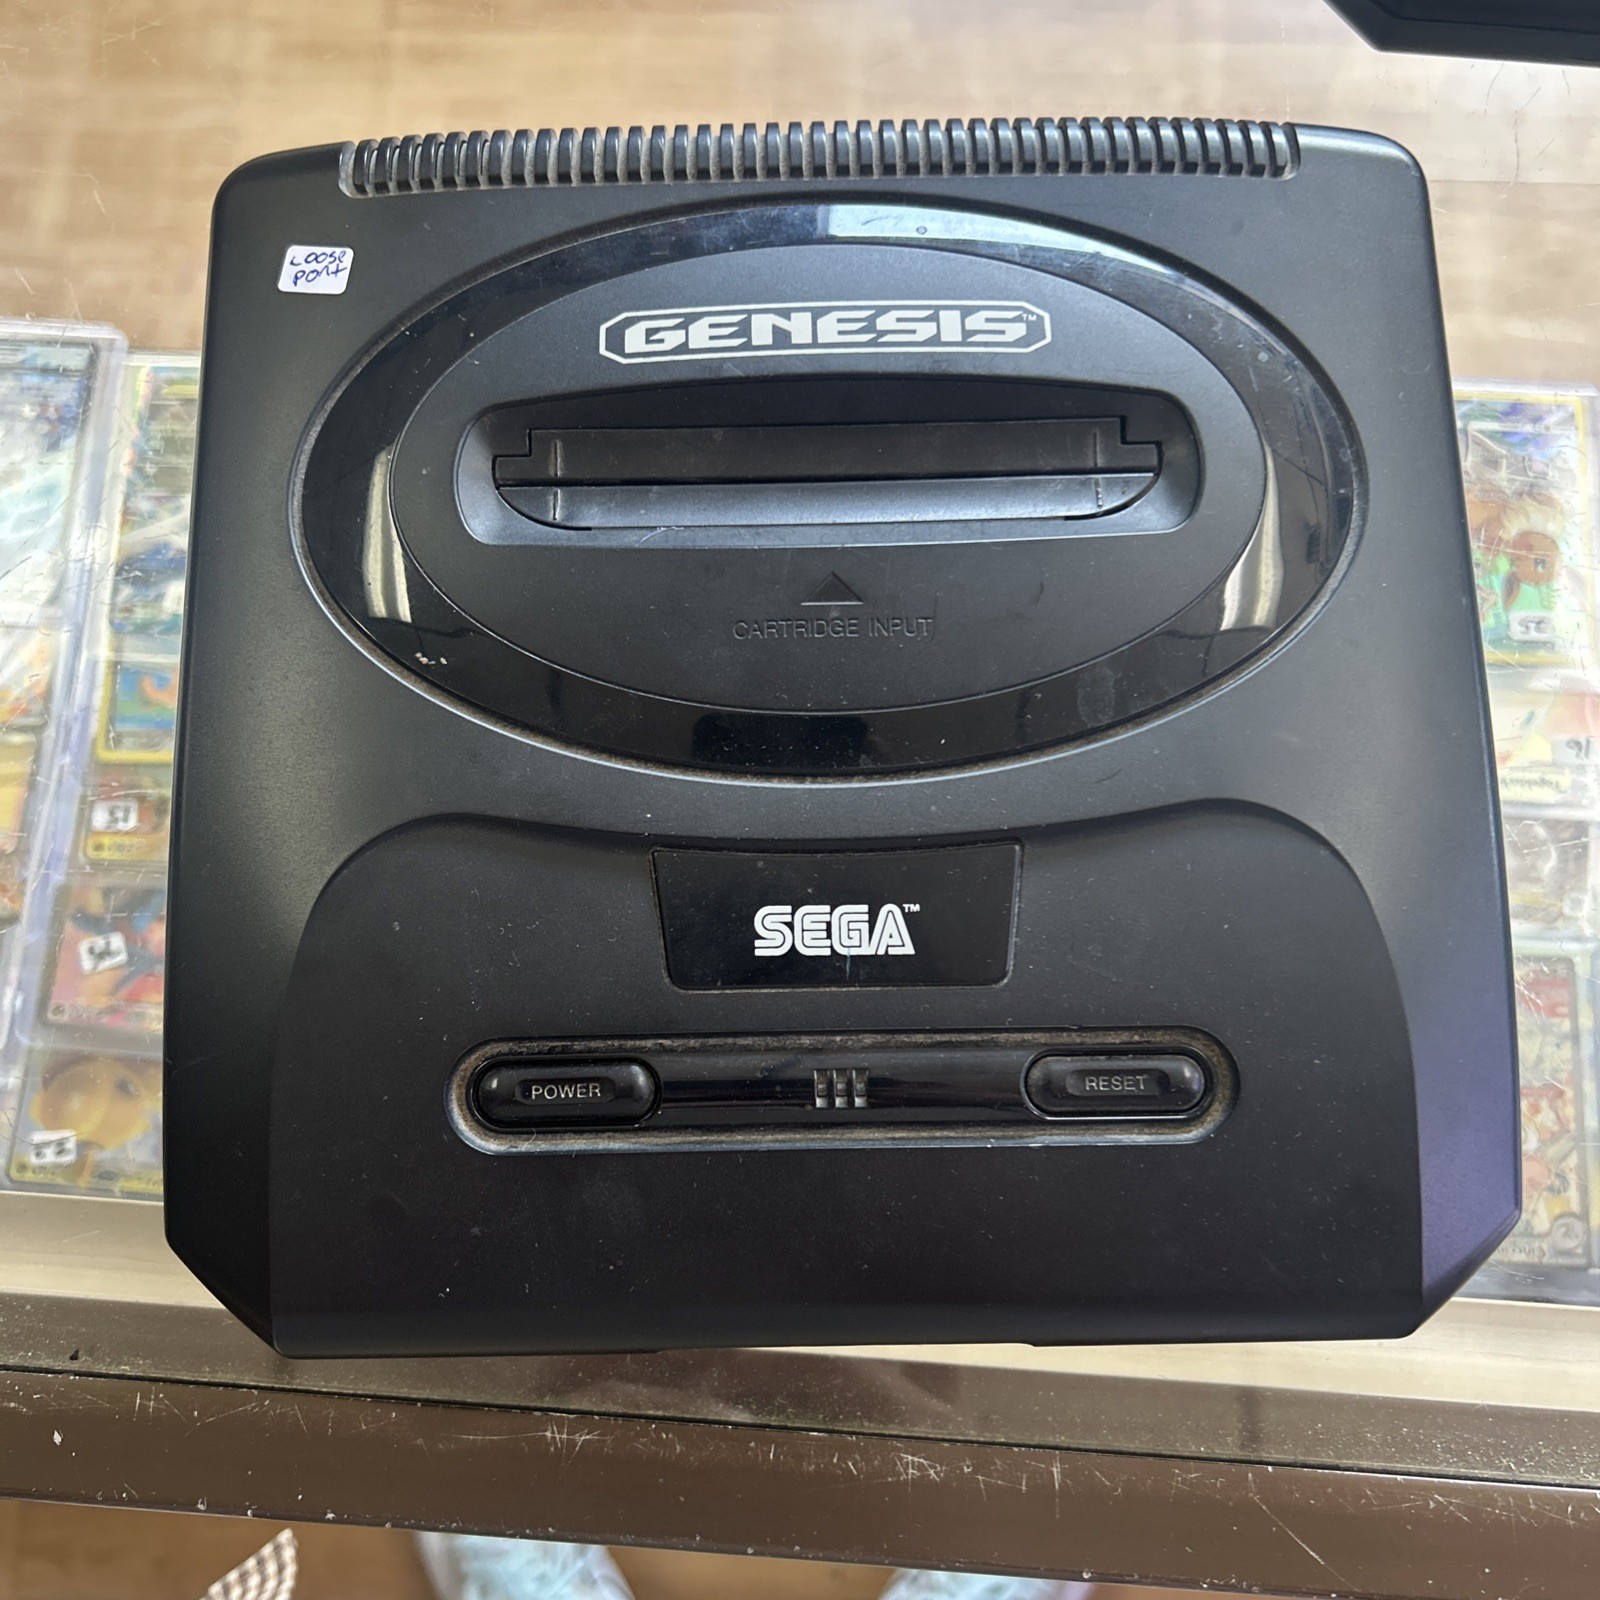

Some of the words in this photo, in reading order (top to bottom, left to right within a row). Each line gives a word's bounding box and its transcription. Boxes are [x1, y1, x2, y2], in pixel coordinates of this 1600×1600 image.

[624, 309, 1027, 354] GENESIS
[732, 617, 860, 640] CARTRIDGE
[867, 616, 933, 637] INPUT
[753, 903, 916, 956] SEGA
[531, 1083, 601, 1100] POWER
[1085, 1074, 1149, 1091] RESET
